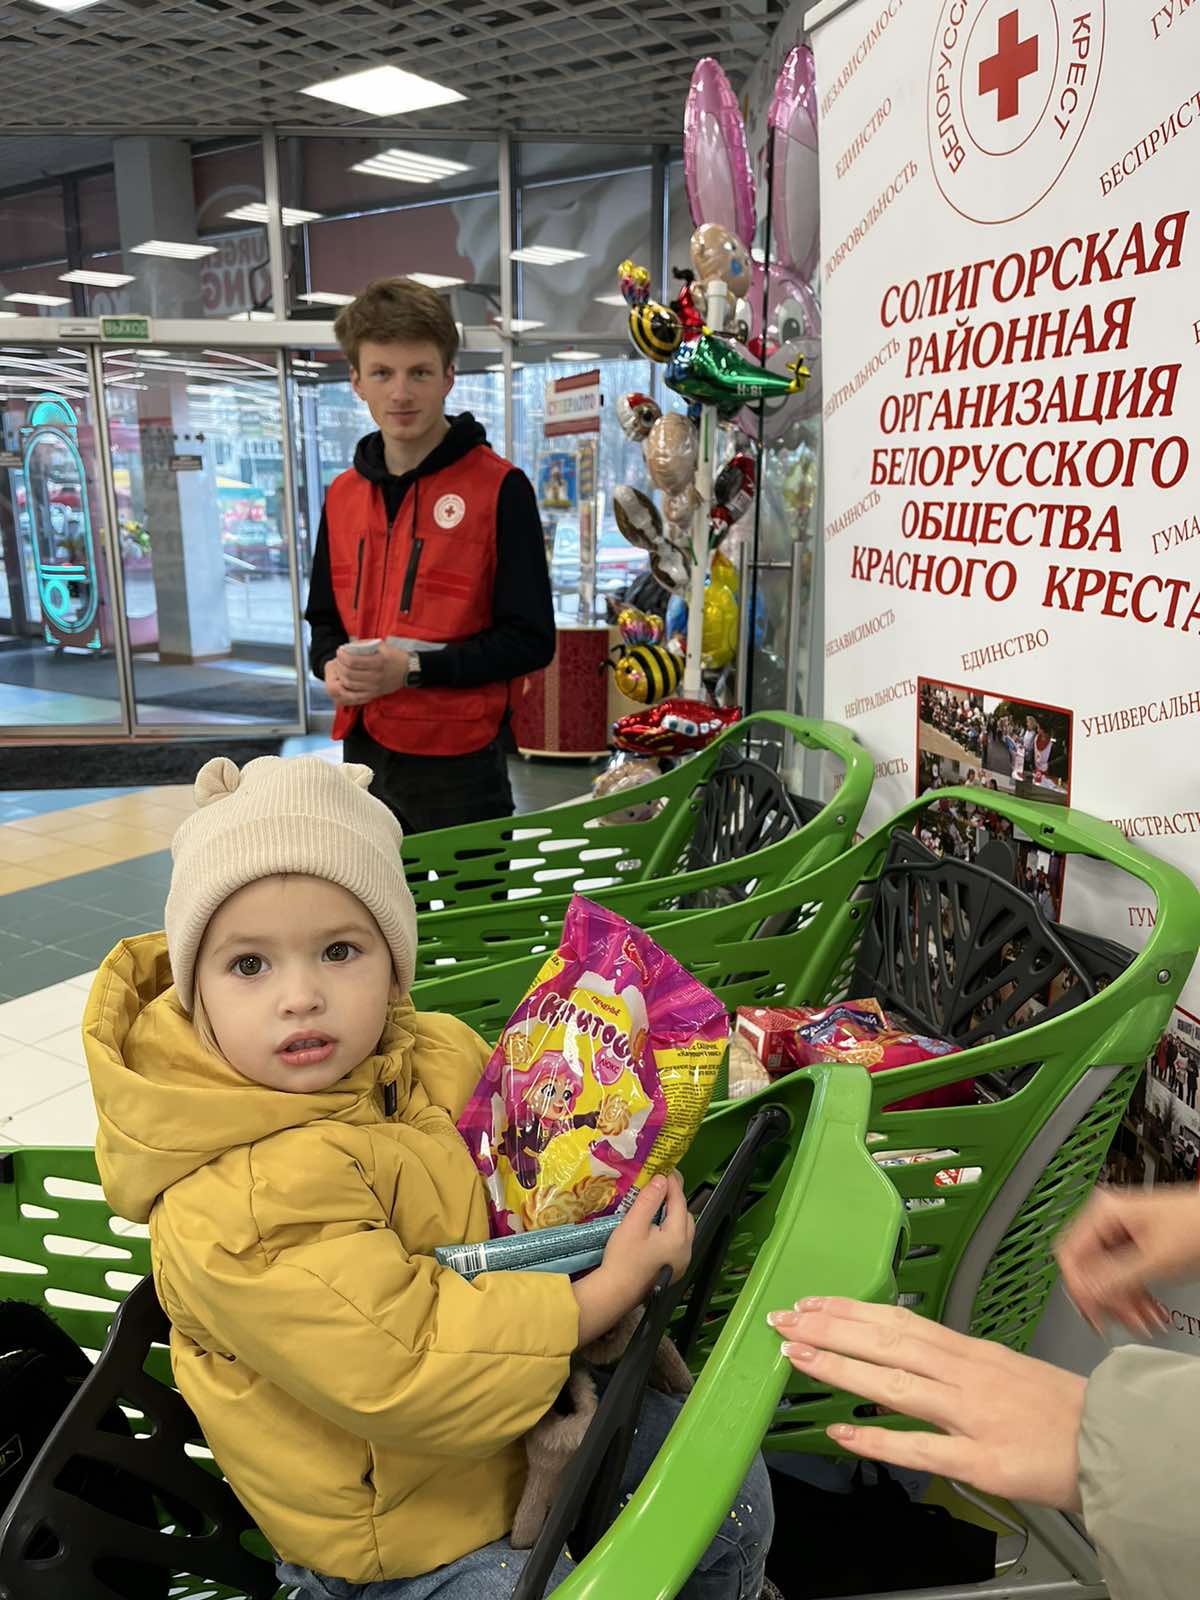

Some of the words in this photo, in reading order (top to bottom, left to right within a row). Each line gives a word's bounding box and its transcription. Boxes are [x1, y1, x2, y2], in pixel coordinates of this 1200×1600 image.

[821, 0, 903, 118] НЕЗАВИСИМОС
[1054, 12, 1092, 140] КРЕСТ
[836, 97, 893, 179] ЕДИНСТВО
[880, 210, 1190, 328] СОЛИГОРСКАЯ
[904, 297, 1136, 379] РАЙОННАЯ
[823, 337, 901, 421] ЕЙТРАЛЬНОСТЬ
[879, 364, 1182, 435] ОРГАНИЗАЦИЯ
[870, 435, 1189, 489] БЕЛОРУССКОГО
[824, 489, 881, 542] УМАННОСТЬ
[902, 500, 1122, 552] ОБЩЕСТВА
[851, 545, 1017, 602] КРАСНОГО
[960, 628, 1050, 672] ЕДИНСТВО
[845, 679, 917, 719] НЕЙТРАЛЬНОСТЬ
